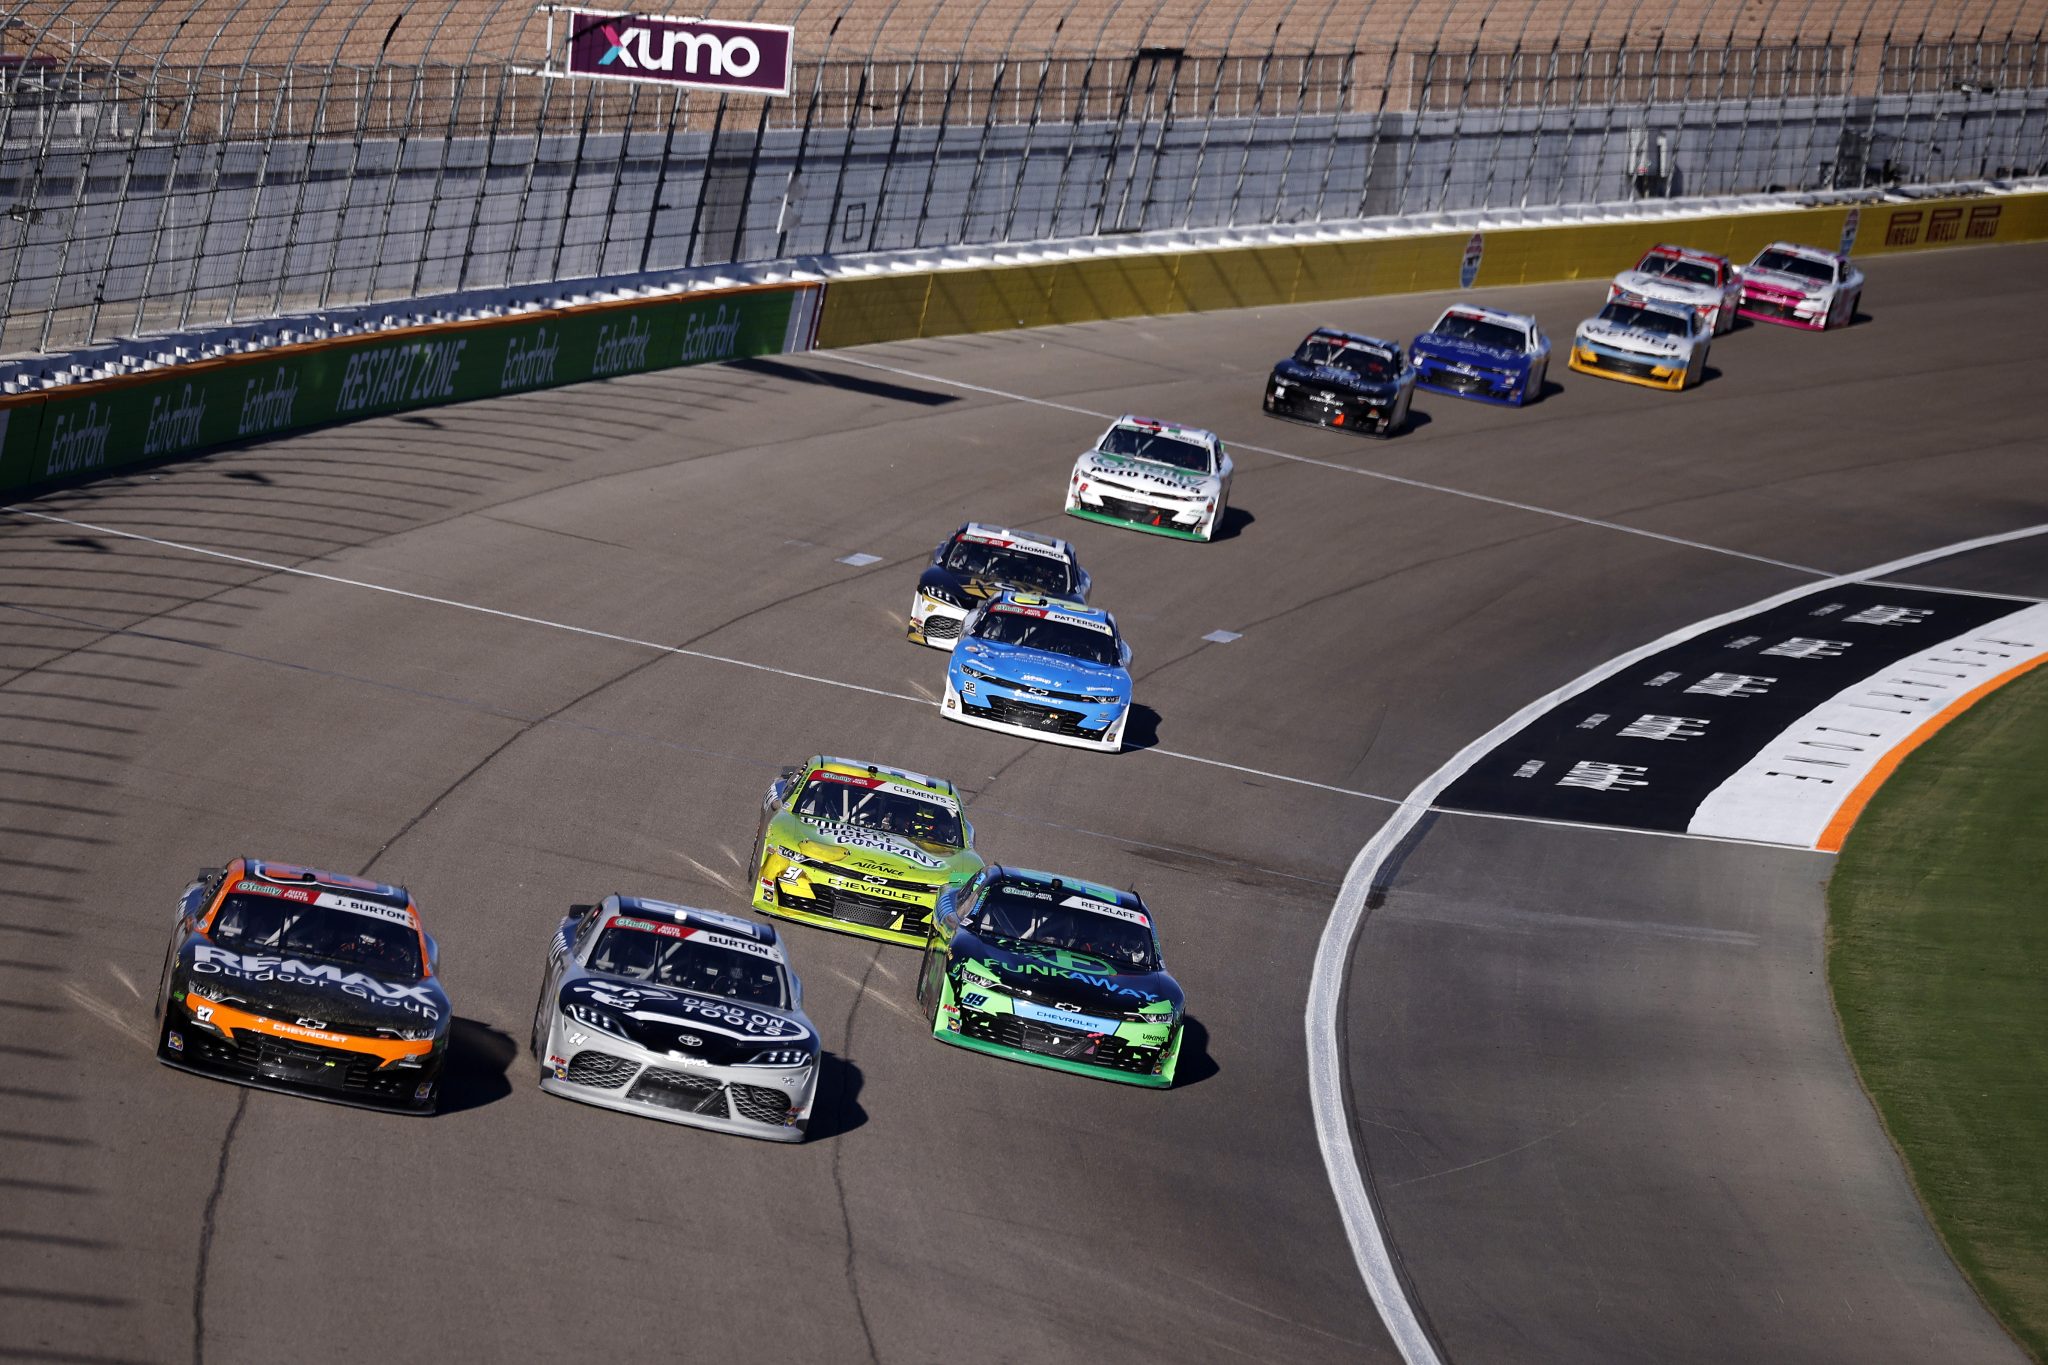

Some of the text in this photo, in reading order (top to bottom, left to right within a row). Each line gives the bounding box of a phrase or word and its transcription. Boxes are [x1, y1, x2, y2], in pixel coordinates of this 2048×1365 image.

[682, 304, 741, 361] EchoPark
[592, 314, 651, 374] EchoPark
[501, 327, 560, 389] EchoPark
[336, 339, 467, 412] RESTART ZONE
[237, 366, 298, 435] EchoPark
[143, 383, 206, 455] EchoPark
[46, 400, 111, 476] EchoPark
[1091, 465, 1202, 495] AUTO PARTS
[1054, 614, 1106, 631] PATTERSON
[965, 681, 975, 691] 32
[893, 785, 947, 804] CLEMENTS
[837, 836, 944, 868] COMPANY
[783, 865, 802, 881] 51
[236, 880, 283, 896] O'Reilly
[283, 892, 309, 902] PARTS
[287, 888, 308, 898] AUTO
[827, 877, 922, 902] CHEVROLET
[335, 899, 406, 922] J. BURTON
[1081, 901, 1137, 920] RETZLAFF
[657, 927, 681, 938] PARTS
[660, 924, 681, 933] AUTO
[708, 935, 769, 956] BURTON
[983, 958, 1160, 1002] FUNKAWAY
[193, 961, 439, 1021] Outdoor Group
[962, 992, 989, 1006] 99
[196, 1005, 216, 1022] 27
[683, 997, 785, 1029] DEAD ON
[684, 1004, 783, 1037] TOOLS
[1036, 1010, 1100, 1029] CHEVROLET
[272, 1023, 348, 1043] CHEVROLET
[568, 1031, 590, 1047] 24
[1142, 1033, 1166, 1043] VIKING
[663, 1050, 712, 1068] Supra
